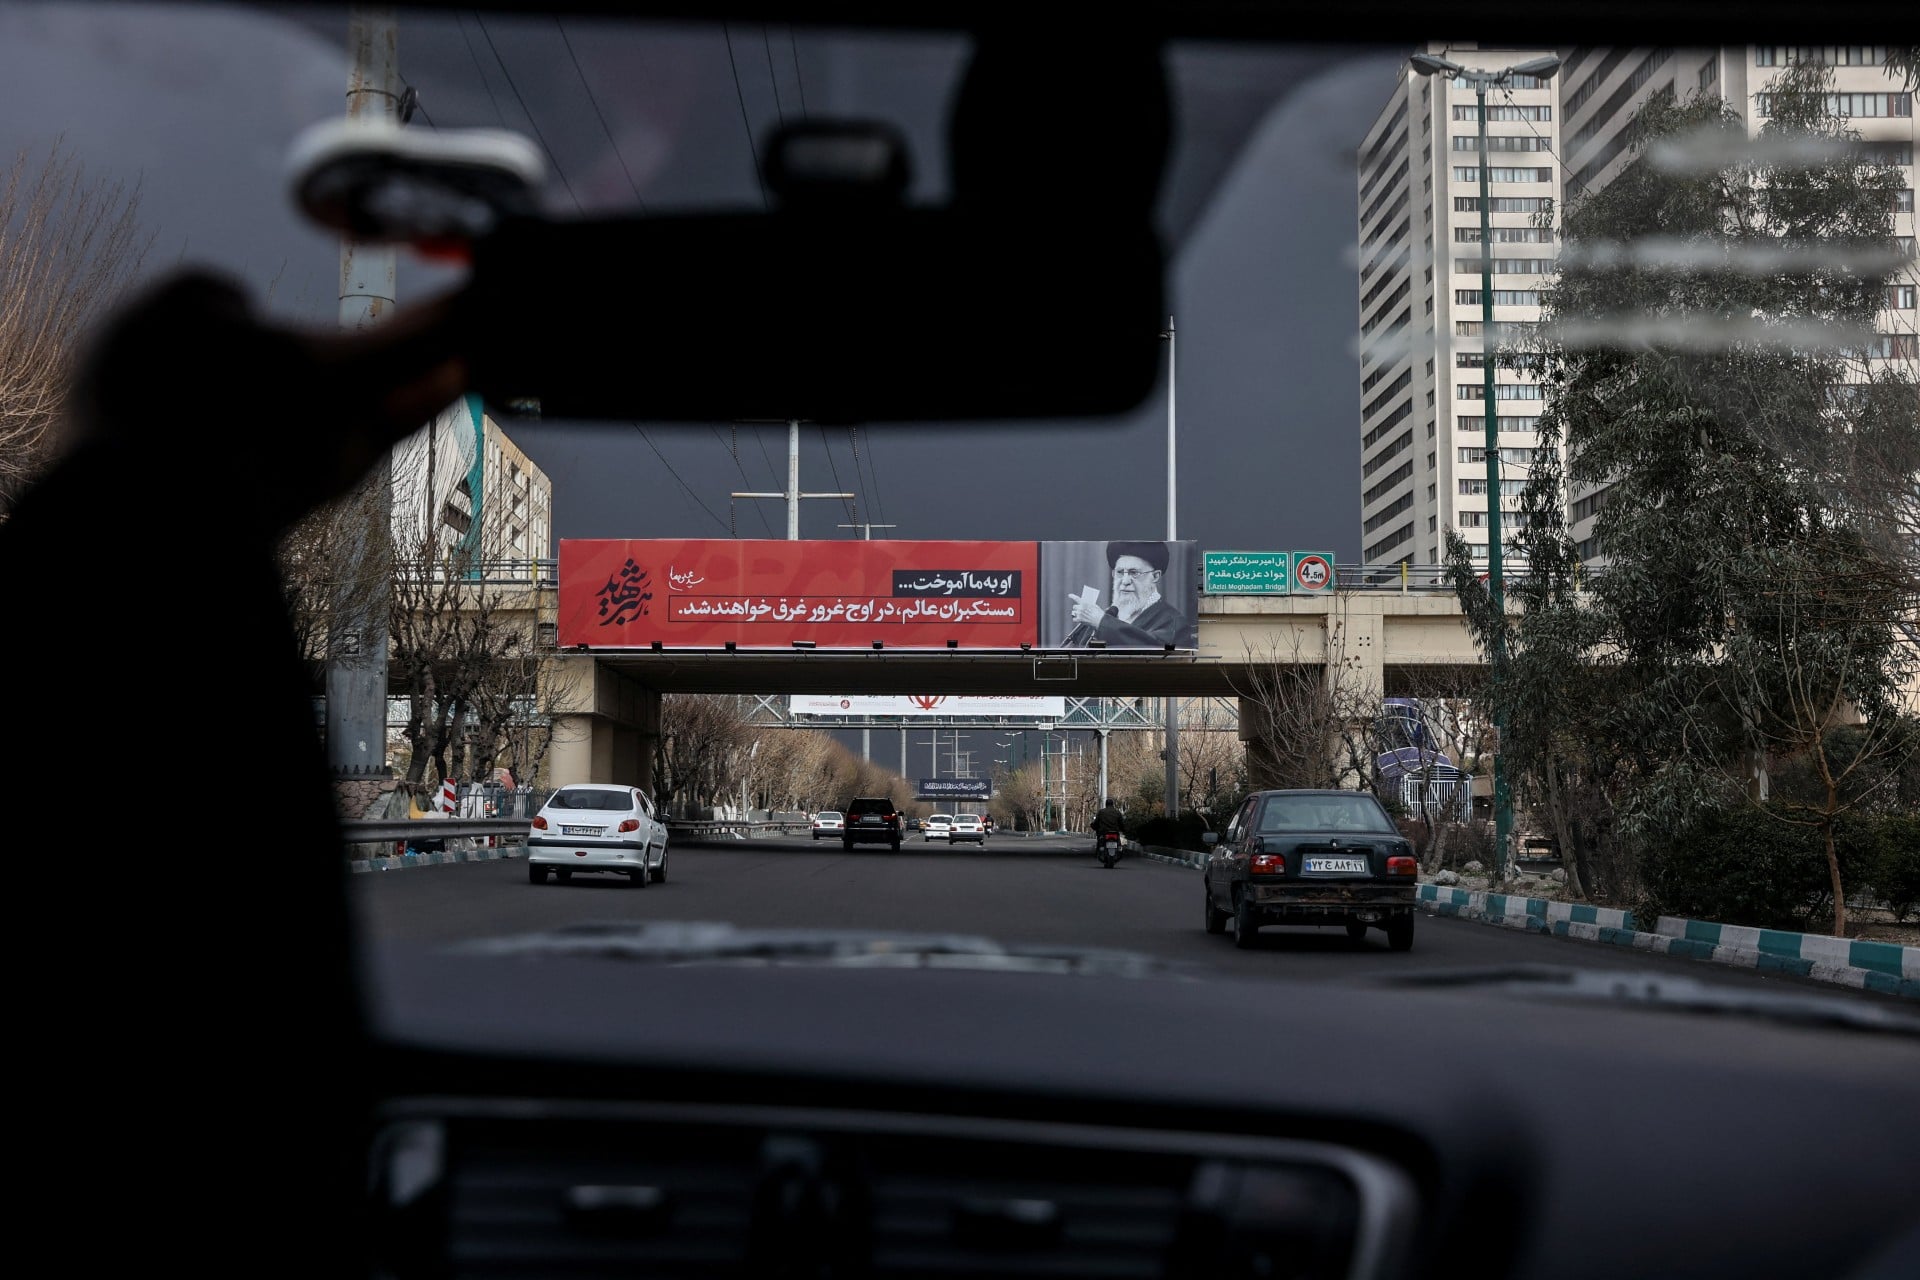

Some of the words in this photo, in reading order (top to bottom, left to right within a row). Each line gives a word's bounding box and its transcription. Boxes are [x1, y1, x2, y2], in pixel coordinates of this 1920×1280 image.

[969, 573, 983, 589] ما
[983, 576, 998, 593] به
[997, 573, 1012, 595] او
[1207, 569, 1232, 581] مقدم
[1263, 570, 1285, 581] جواد
[772, 598, 807, 621] غرق
[806, 598, 845, 622] غرور
[846, 599, 874, 622] اوج
[873, 602, 895, 622] در
[939, 599, 1015, 622] مستکبران
